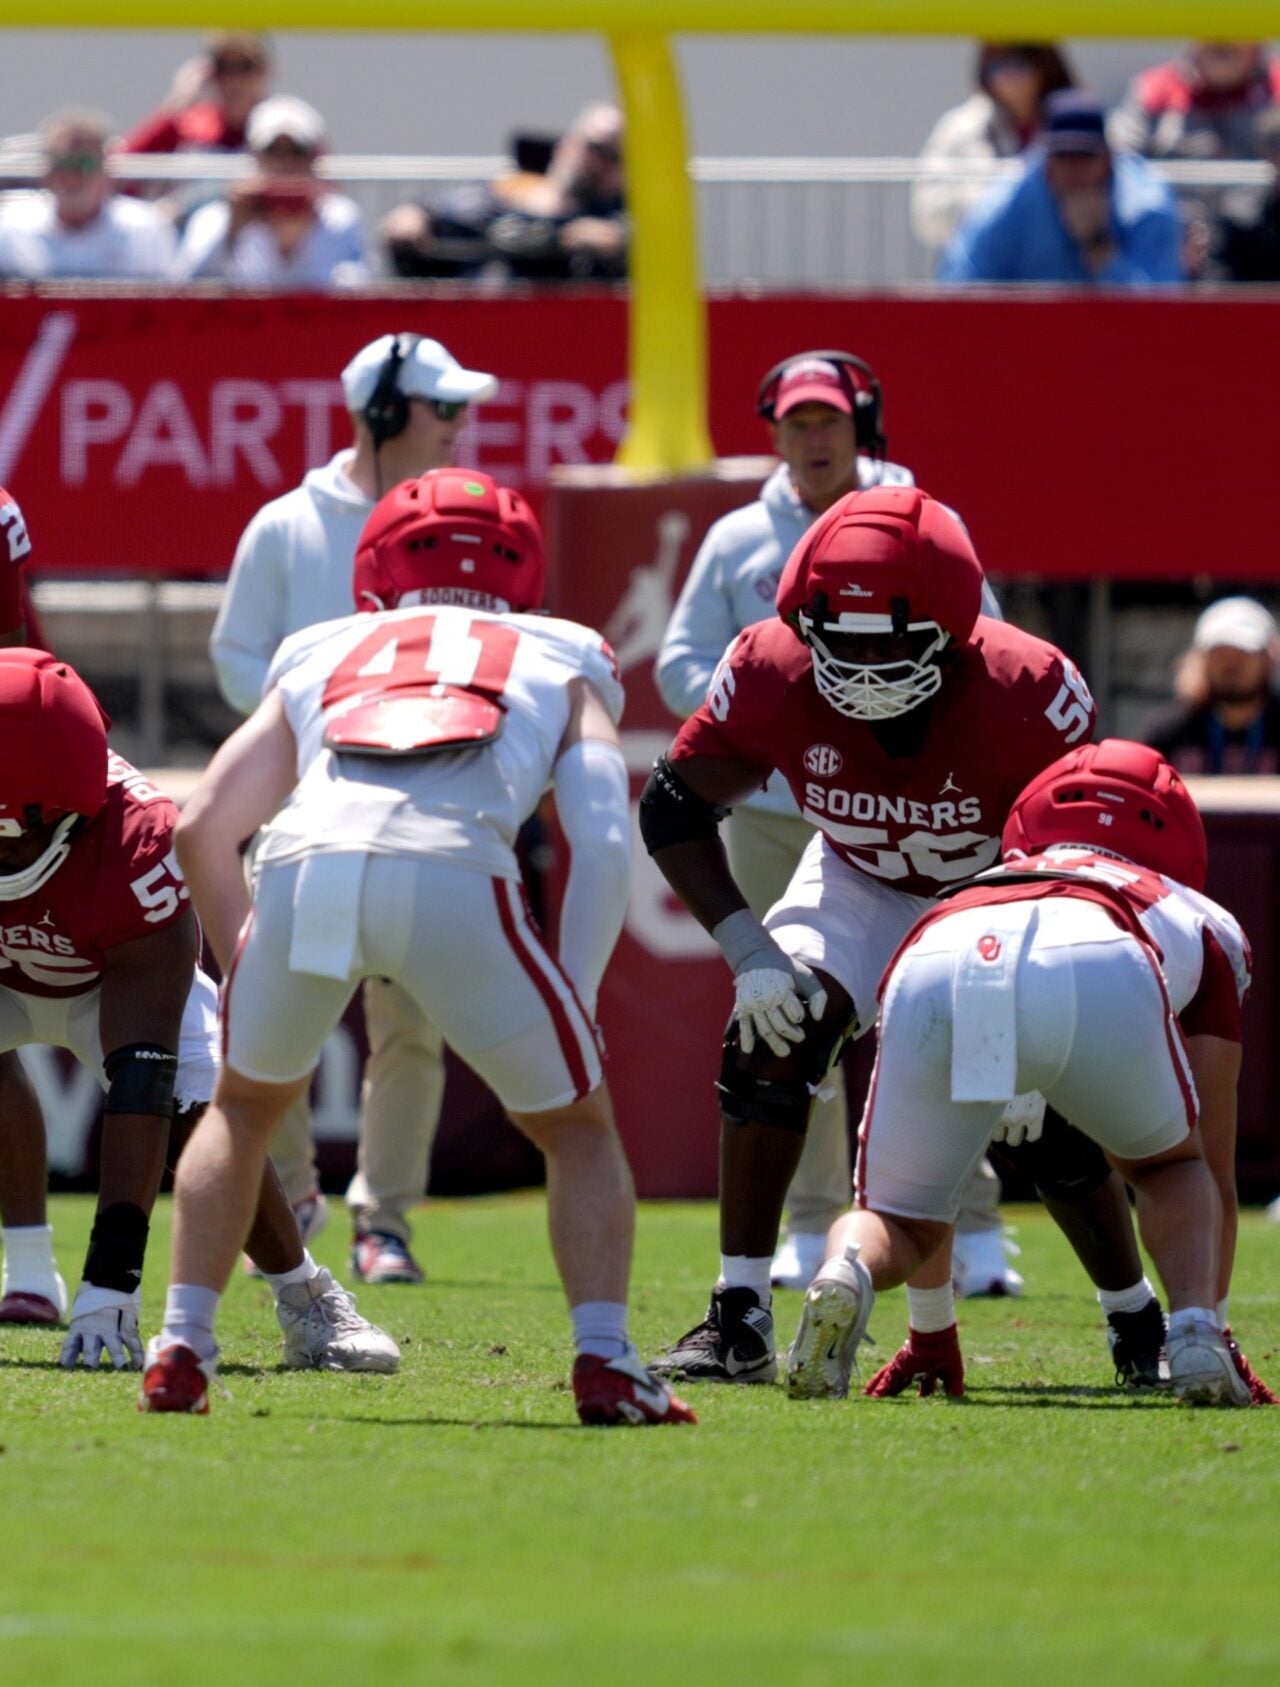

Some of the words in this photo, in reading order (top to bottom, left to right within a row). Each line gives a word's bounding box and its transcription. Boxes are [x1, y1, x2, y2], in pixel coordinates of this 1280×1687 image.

[322, 615, 520, 707] 41
[806, 748, 841, 775] SEC
[805, 782, 982, 830] SOONERS
